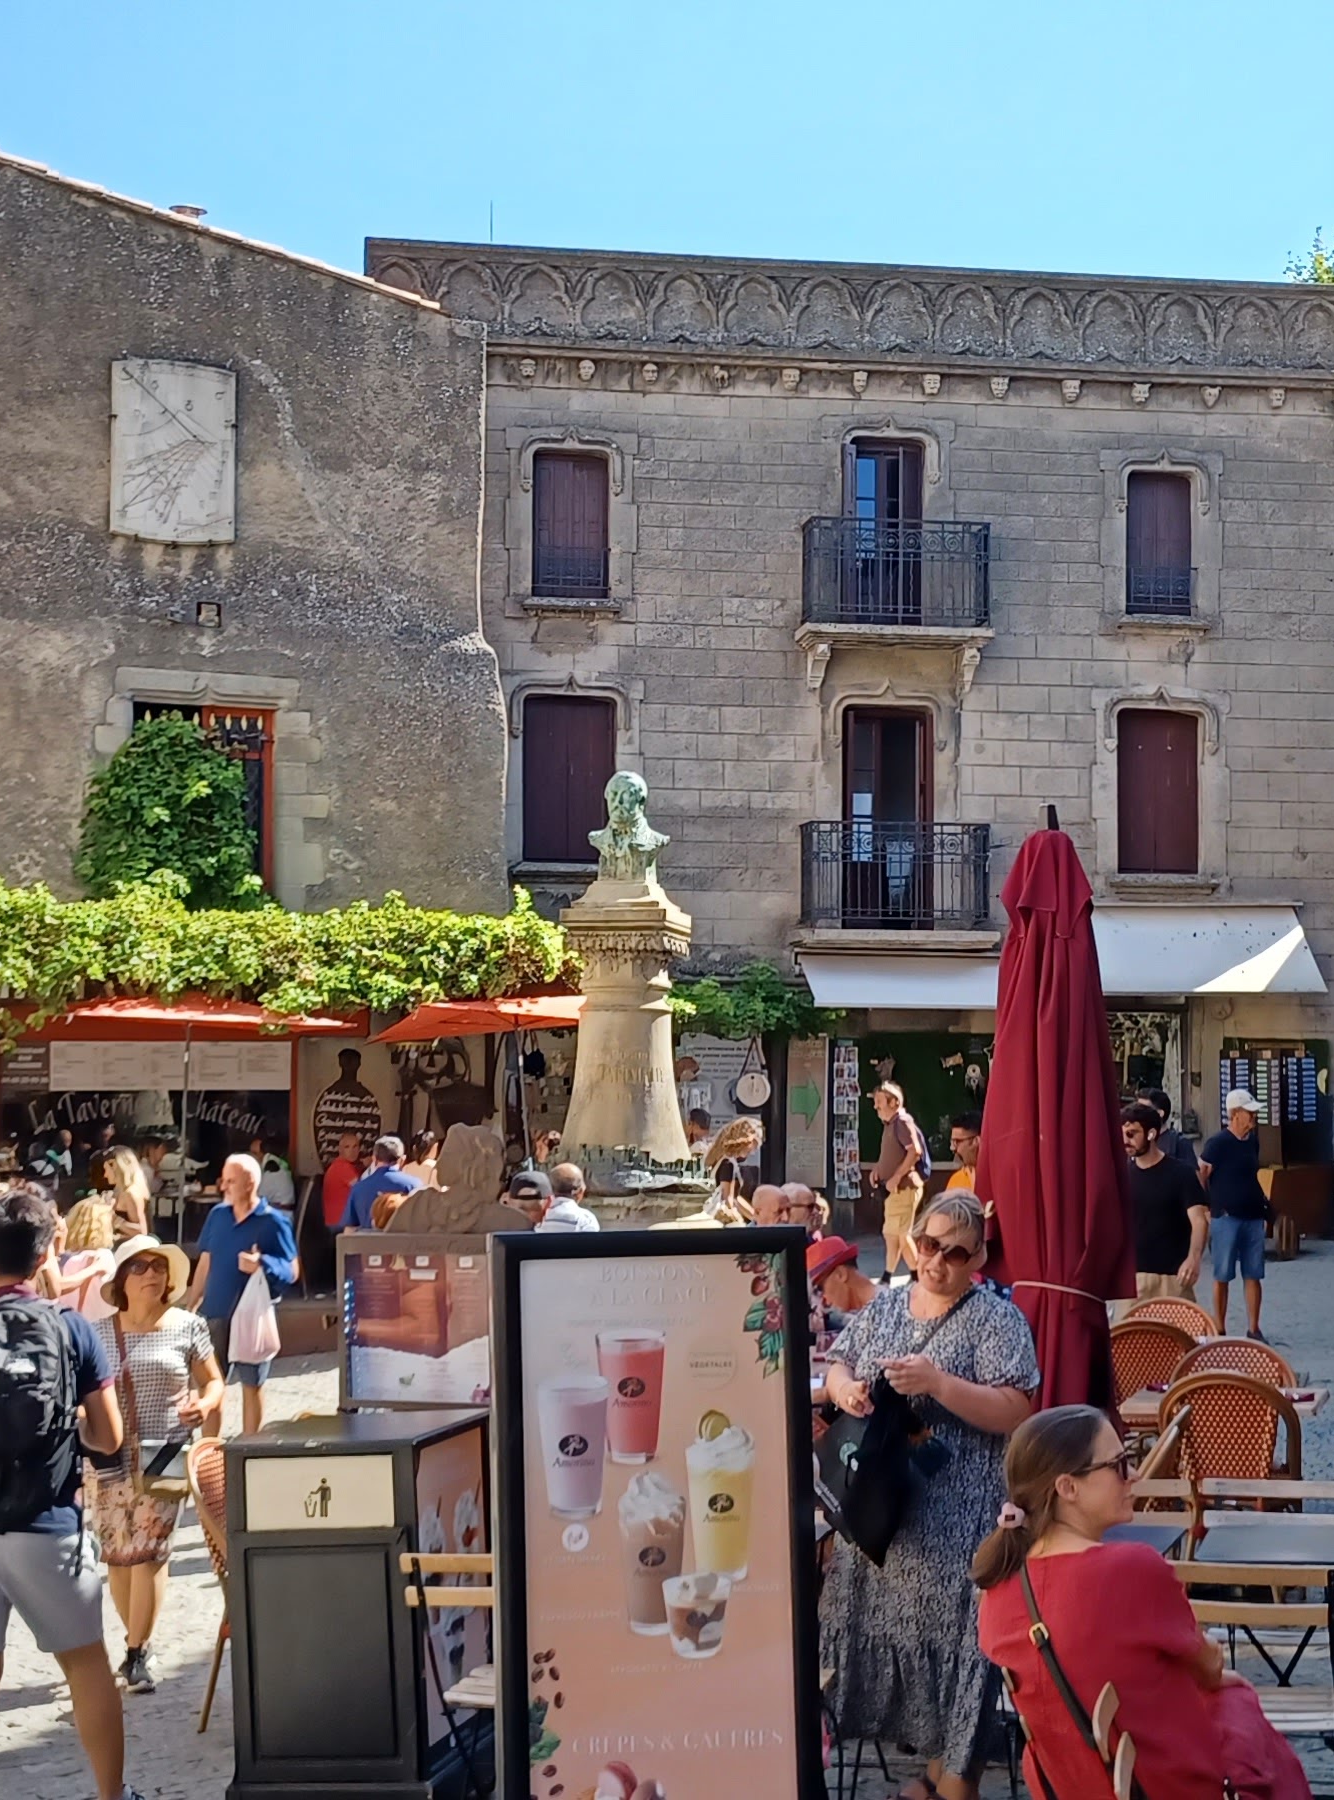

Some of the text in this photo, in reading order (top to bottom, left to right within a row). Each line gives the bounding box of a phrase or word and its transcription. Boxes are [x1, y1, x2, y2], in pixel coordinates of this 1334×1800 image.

[28, 1100, 57, 1135] La
[57, 1091, 145, 1124] Tavern
[599, 1263, 706, 1283] BOISSONS
[611, 1287, 636, 1304] LA
[643, 1286, 715, 1304] GLACE
[683, 1728, 784, 1751] GAUFRES
